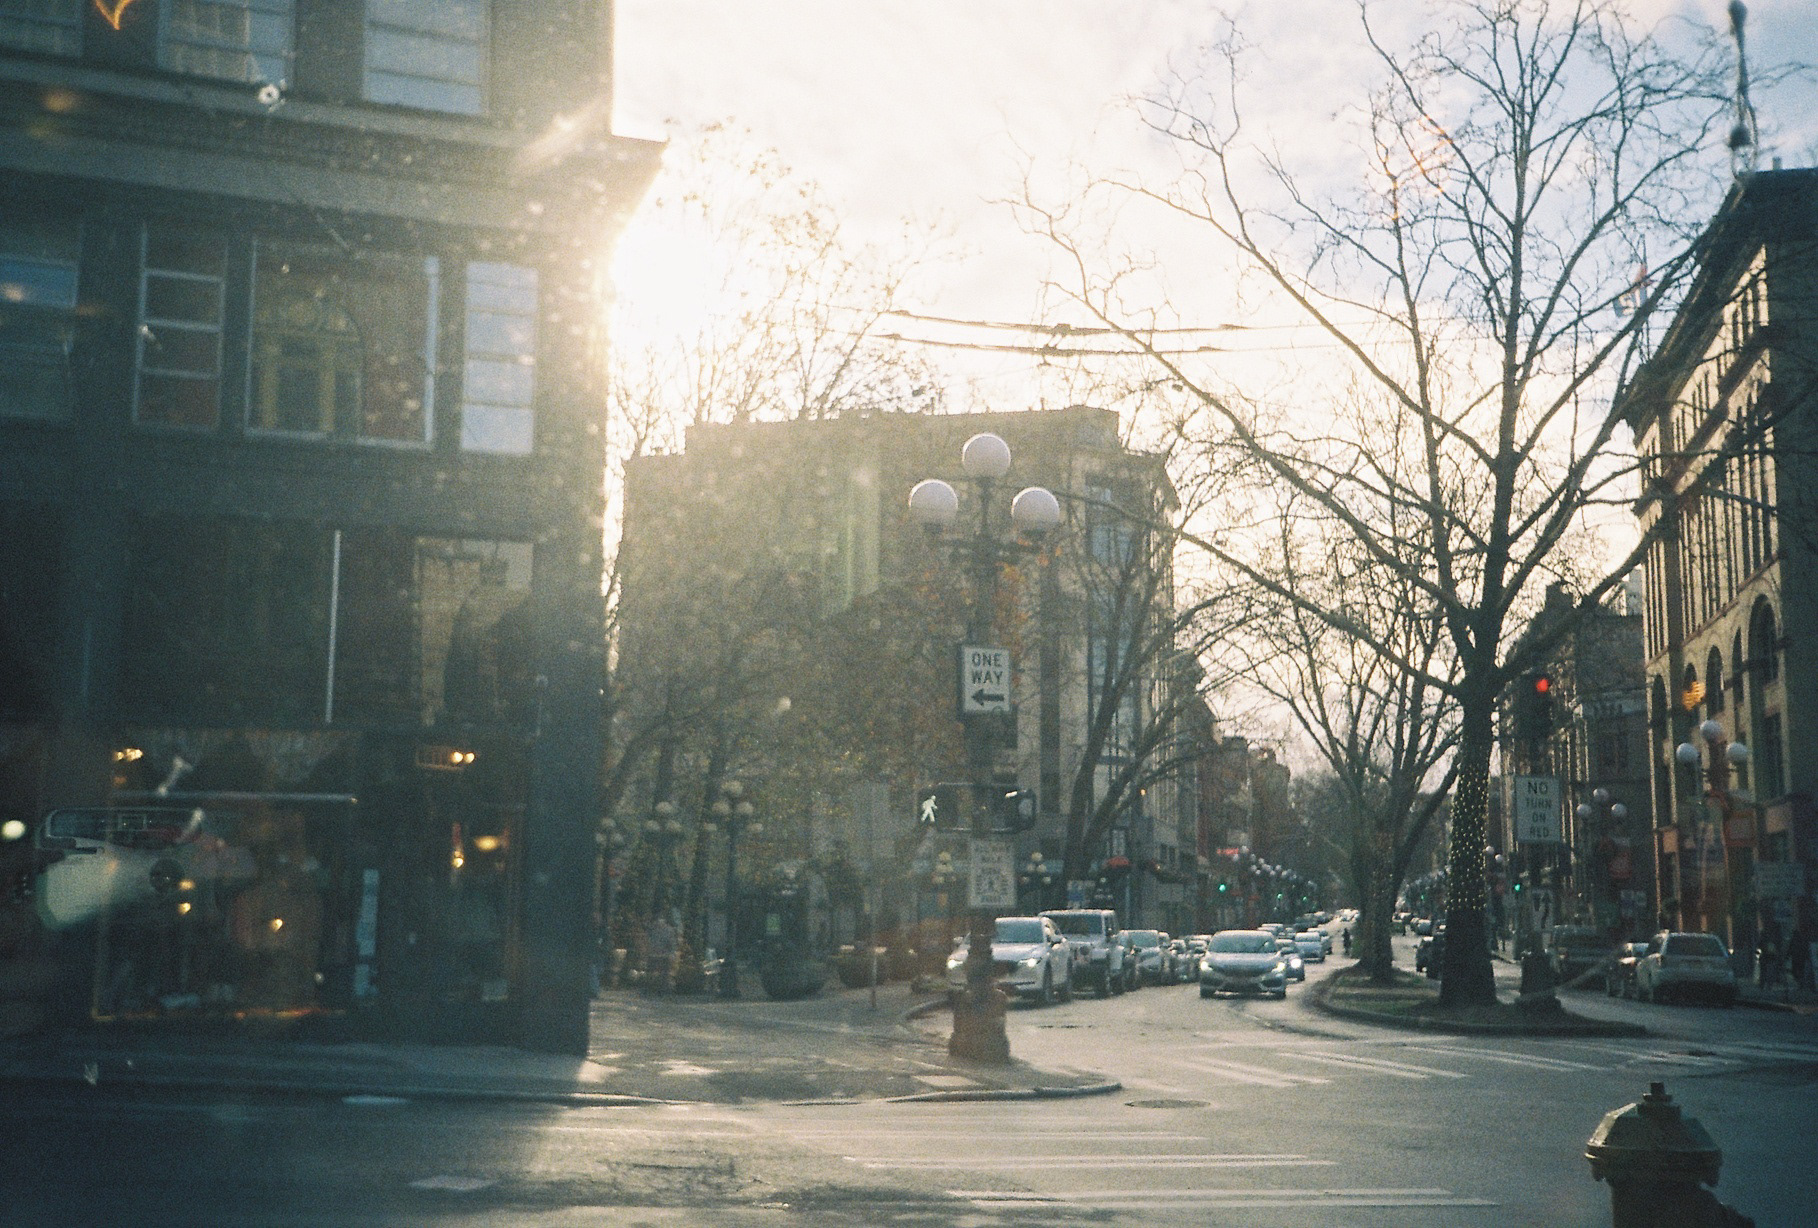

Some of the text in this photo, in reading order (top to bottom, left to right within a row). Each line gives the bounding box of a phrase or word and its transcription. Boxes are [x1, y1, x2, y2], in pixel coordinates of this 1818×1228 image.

[971, 652, 1002, 667] ONE
[971, 670, 1003, 685] WAY
[1527, 780, 1548, 795] NO
[1525, 797, 1552, 809] TURN
[1532, 811, 1546, 823] ON
[1530, 825, 1549, 838] RED
